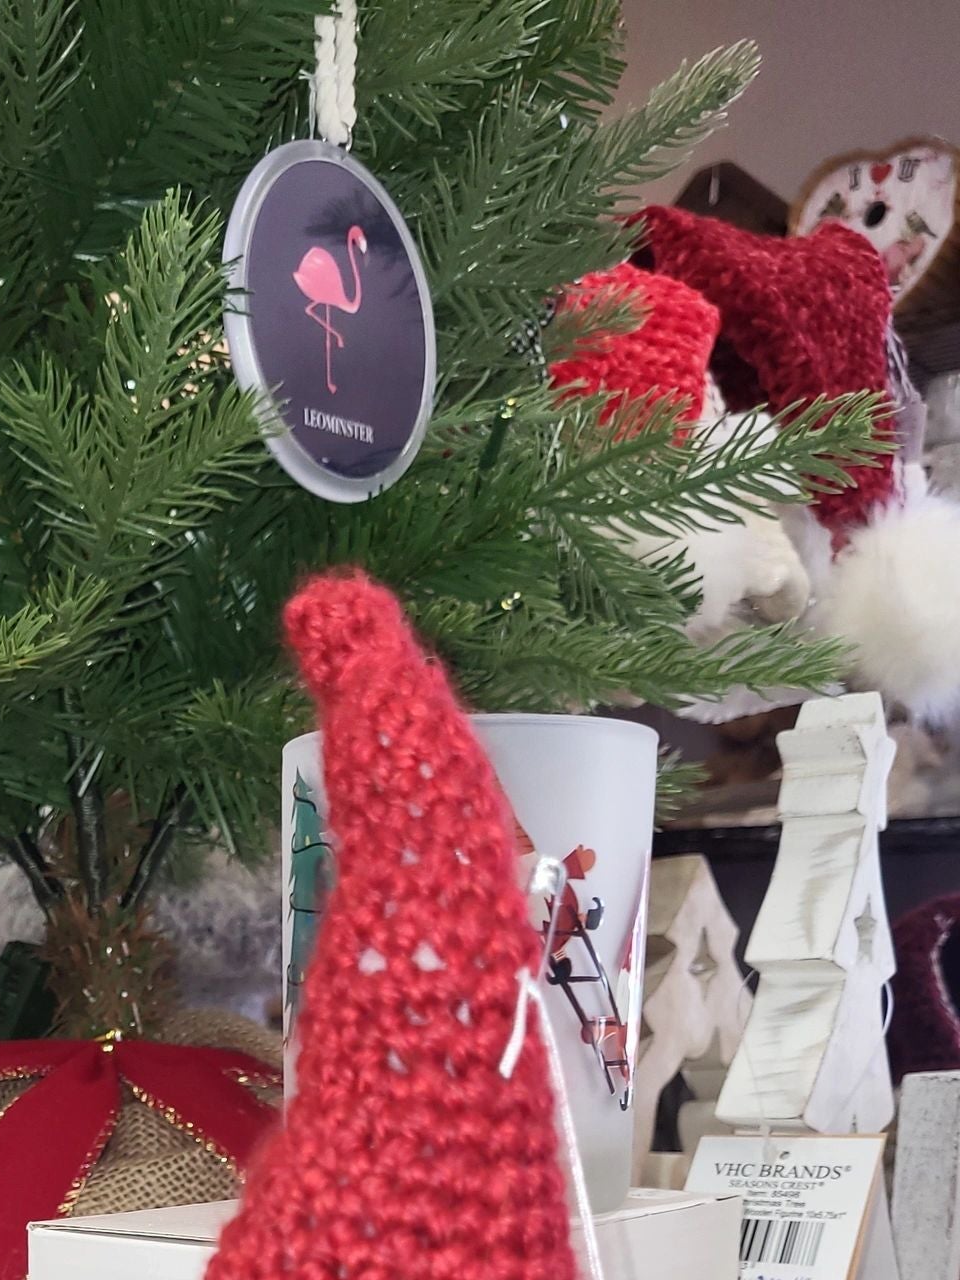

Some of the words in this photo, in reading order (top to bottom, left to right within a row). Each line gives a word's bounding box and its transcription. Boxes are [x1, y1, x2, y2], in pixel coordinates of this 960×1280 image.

[304, 407, 375, 444] LEOMINSTER
[714, 1162, 755, 1177] VHC
[728, 1180, 778, 1189] SEASONS
